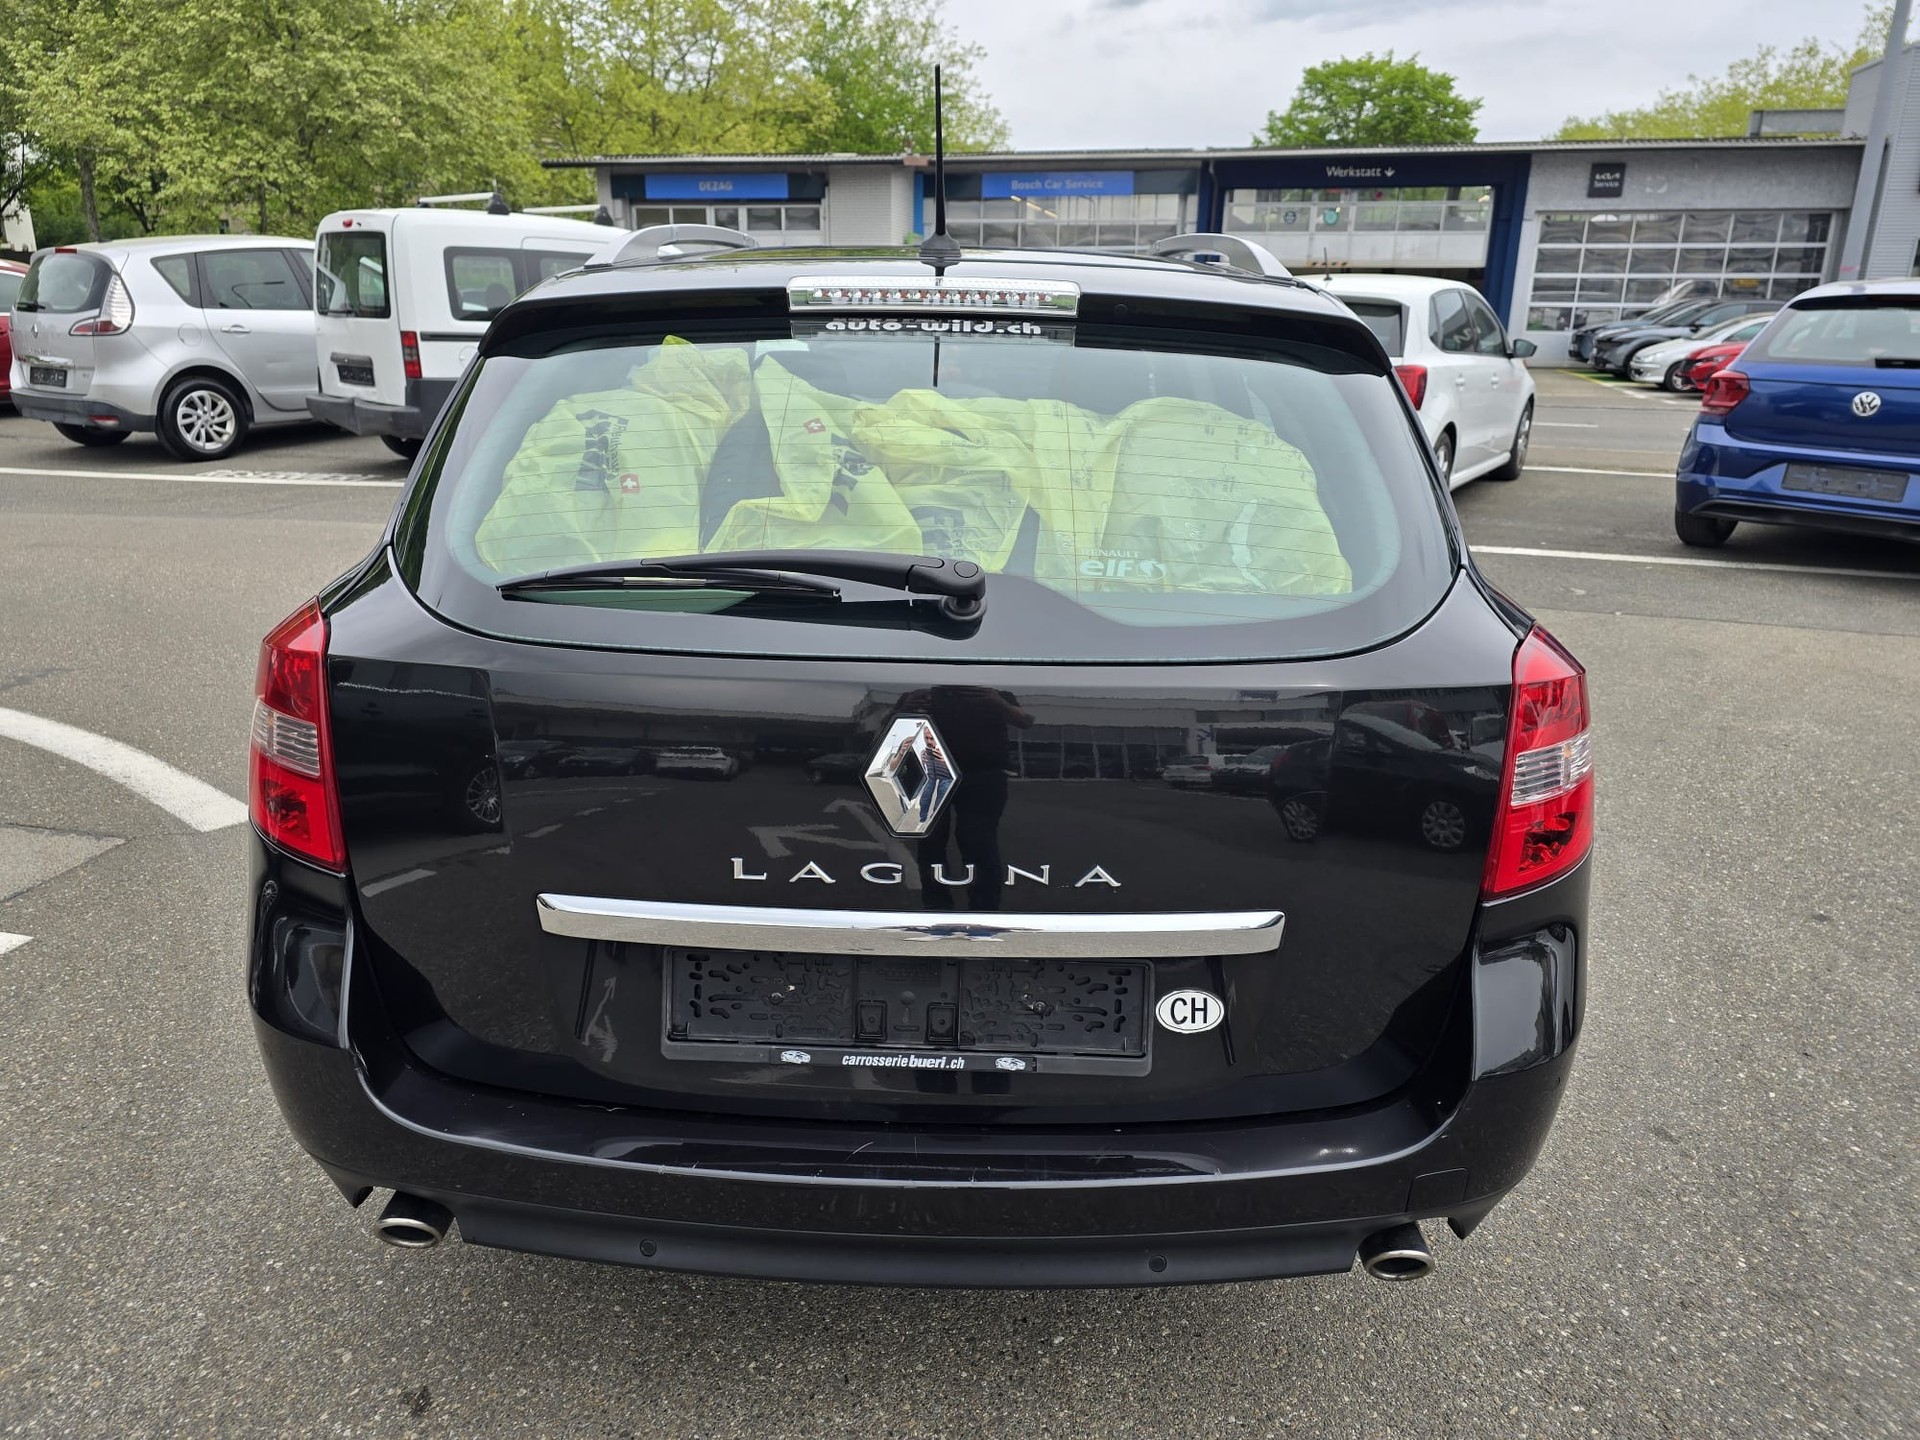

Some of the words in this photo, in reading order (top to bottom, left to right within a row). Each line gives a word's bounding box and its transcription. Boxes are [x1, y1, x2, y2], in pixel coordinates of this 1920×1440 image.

[1326, 166, 1381, 177] Werkstatt
[1011, 180, 1042, 190] Bosch
[1044, 179, 1063, 189] Car
[1066, 179, 1104, 189] Service
[825, 319, 1042, 335] auto-wild.ch
[1082, 549, 1139, 559] RENAULT
[1080, 559, 1135, 577] elf
[730, 857, 1121, 888] LAGUNA
[1170, 997, 1207, 1025] CH
[841, 1055, 965, 1070] carrosseriebueri.ch
